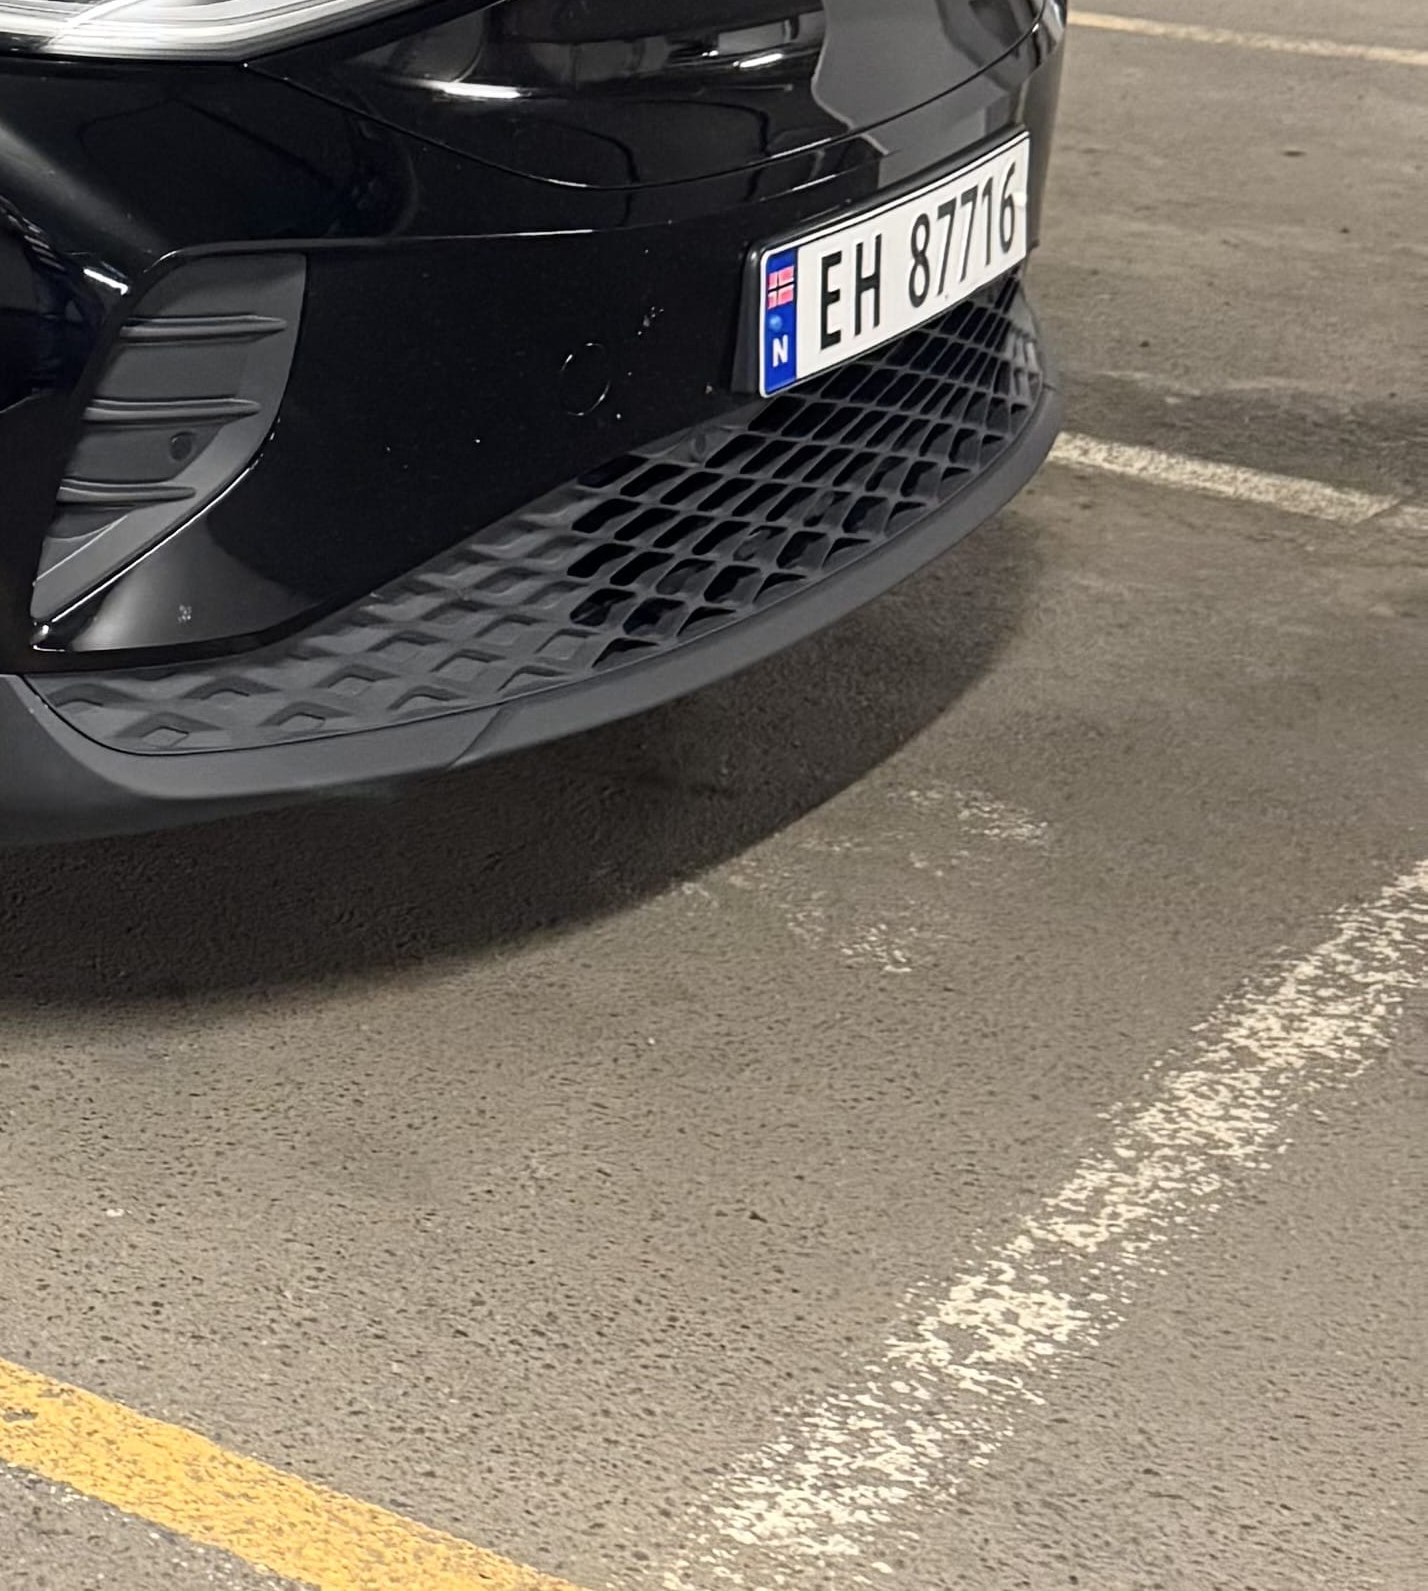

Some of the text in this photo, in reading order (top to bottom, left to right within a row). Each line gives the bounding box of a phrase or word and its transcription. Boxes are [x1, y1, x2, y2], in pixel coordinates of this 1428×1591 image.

[820, 162, 1016, 350] EH 87716
[772, 335, 789, 368] N
